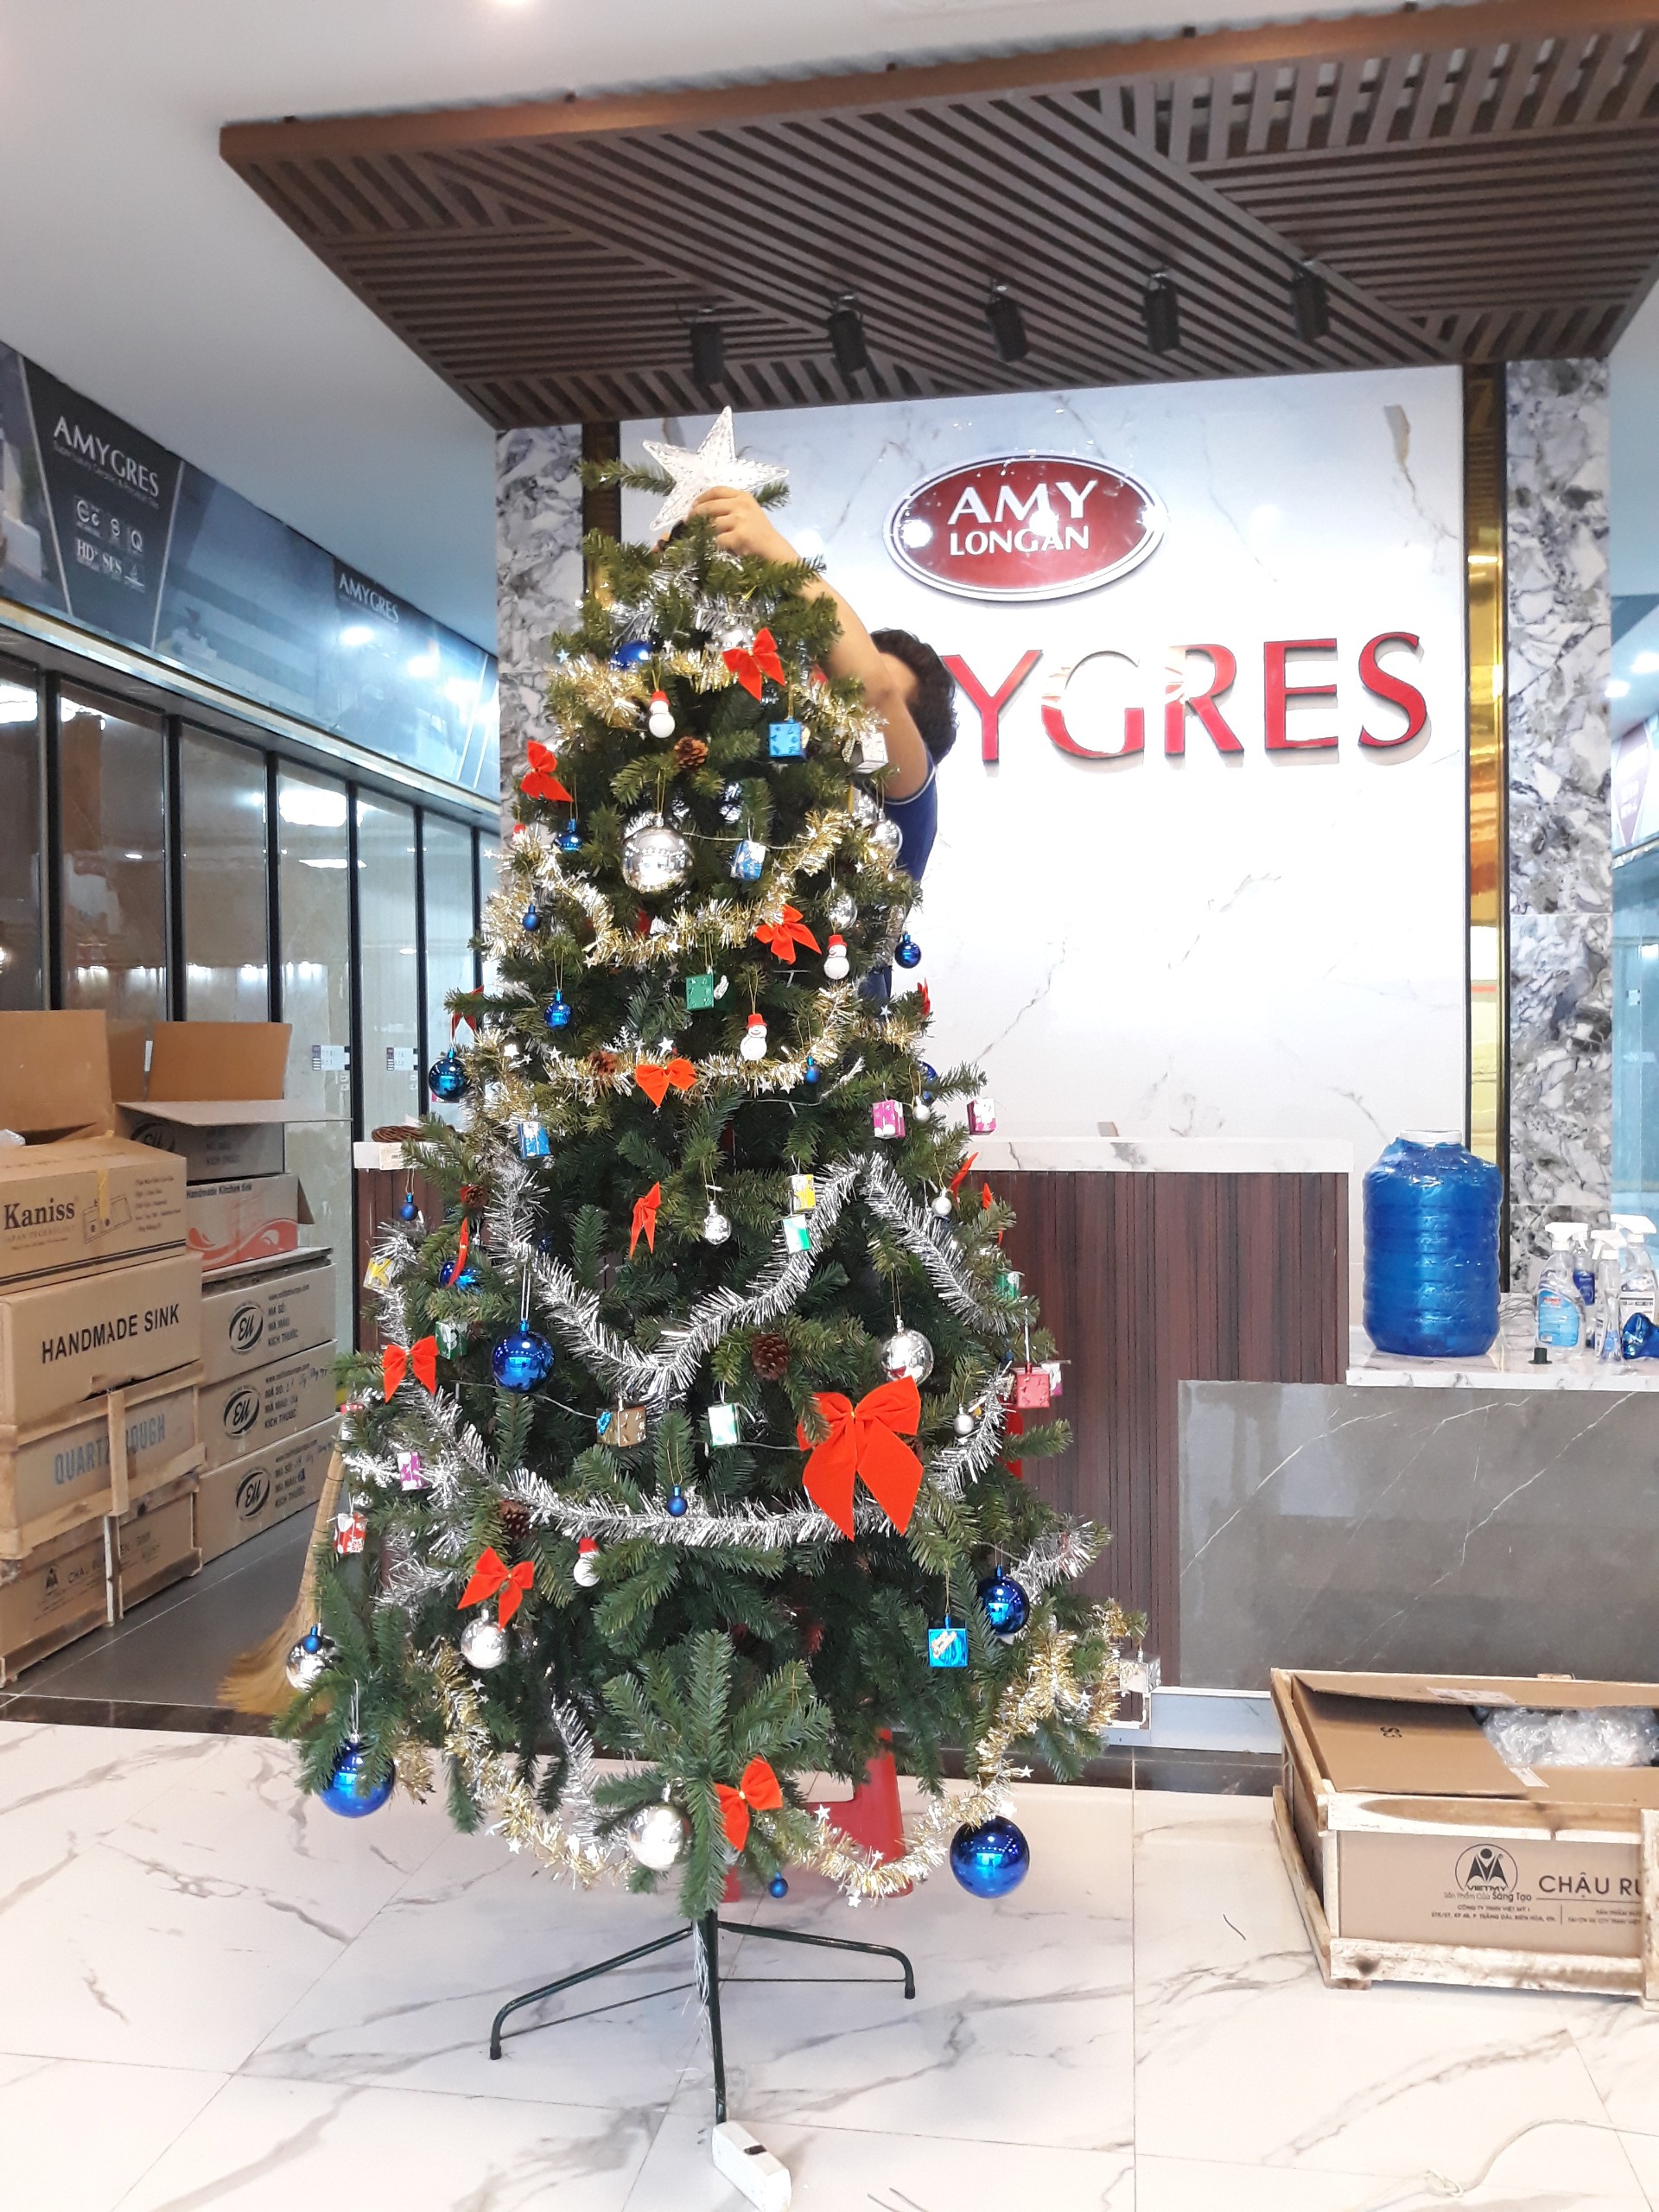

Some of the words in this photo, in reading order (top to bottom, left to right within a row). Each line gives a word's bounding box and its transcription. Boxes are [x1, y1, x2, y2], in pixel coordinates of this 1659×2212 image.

[54, 416, 159, 497] AMYGRES
[947, 480, 1098, 524] AMY
[950, 525, 1089, 556] LONGAN
[339, 573, 398, 623] AMYGRES
[940, 632, 1427, 762] YGRES
[3, 1198, 75, 1230] Kaniss
[41, 1313, 138, 1364] HANDMADE
[144, 1303, 180, 1332] SINK
[1539, 1872, 1610, 1898] CHẬU
